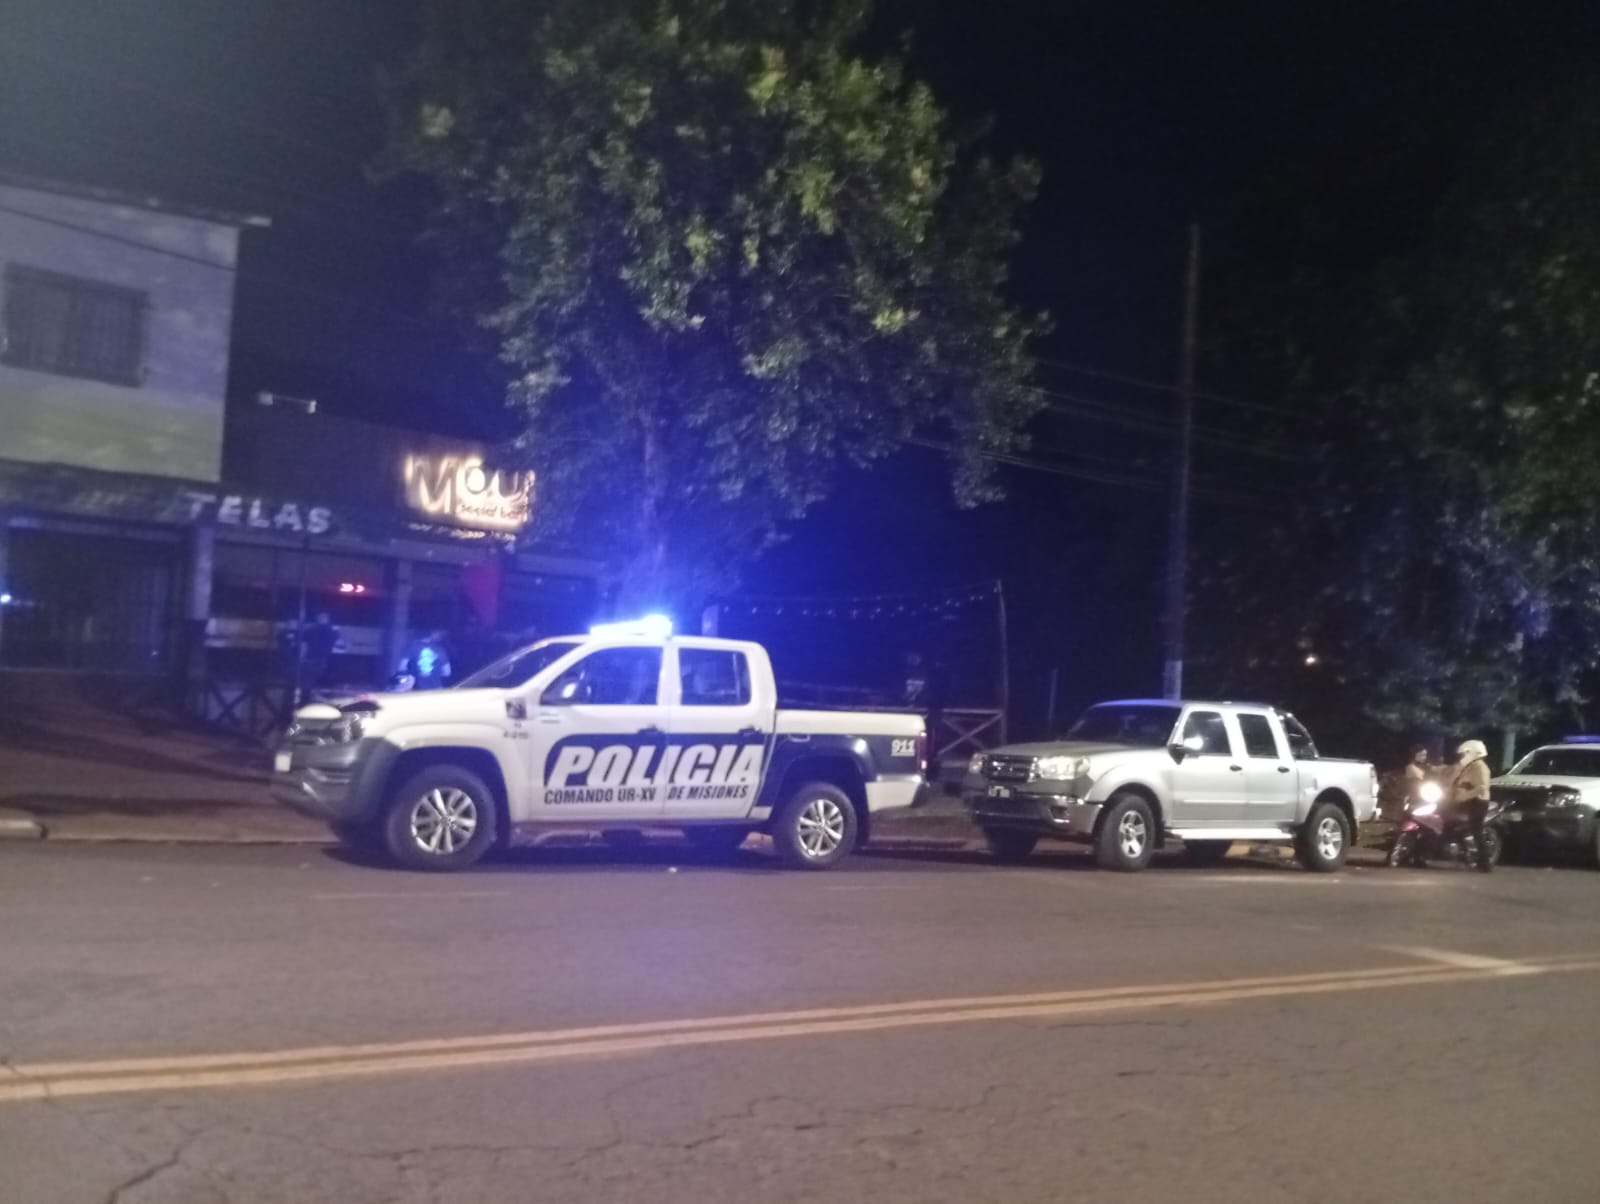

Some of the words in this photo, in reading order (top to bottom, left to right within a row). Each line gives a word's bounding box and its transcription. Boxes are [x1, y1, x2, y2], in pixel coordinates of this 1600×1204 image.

[186, 491, 331, 533] TELAS
[891, 738, 916, 753] 911
[547, 744, 765, 787] POLICIA
[544, 787, 613, 805] COMANDO
[617, 786, 656, 803] UR-XV
[668, 785, 682, 800] DE
[687, 784, 749, 799] MISIONES
